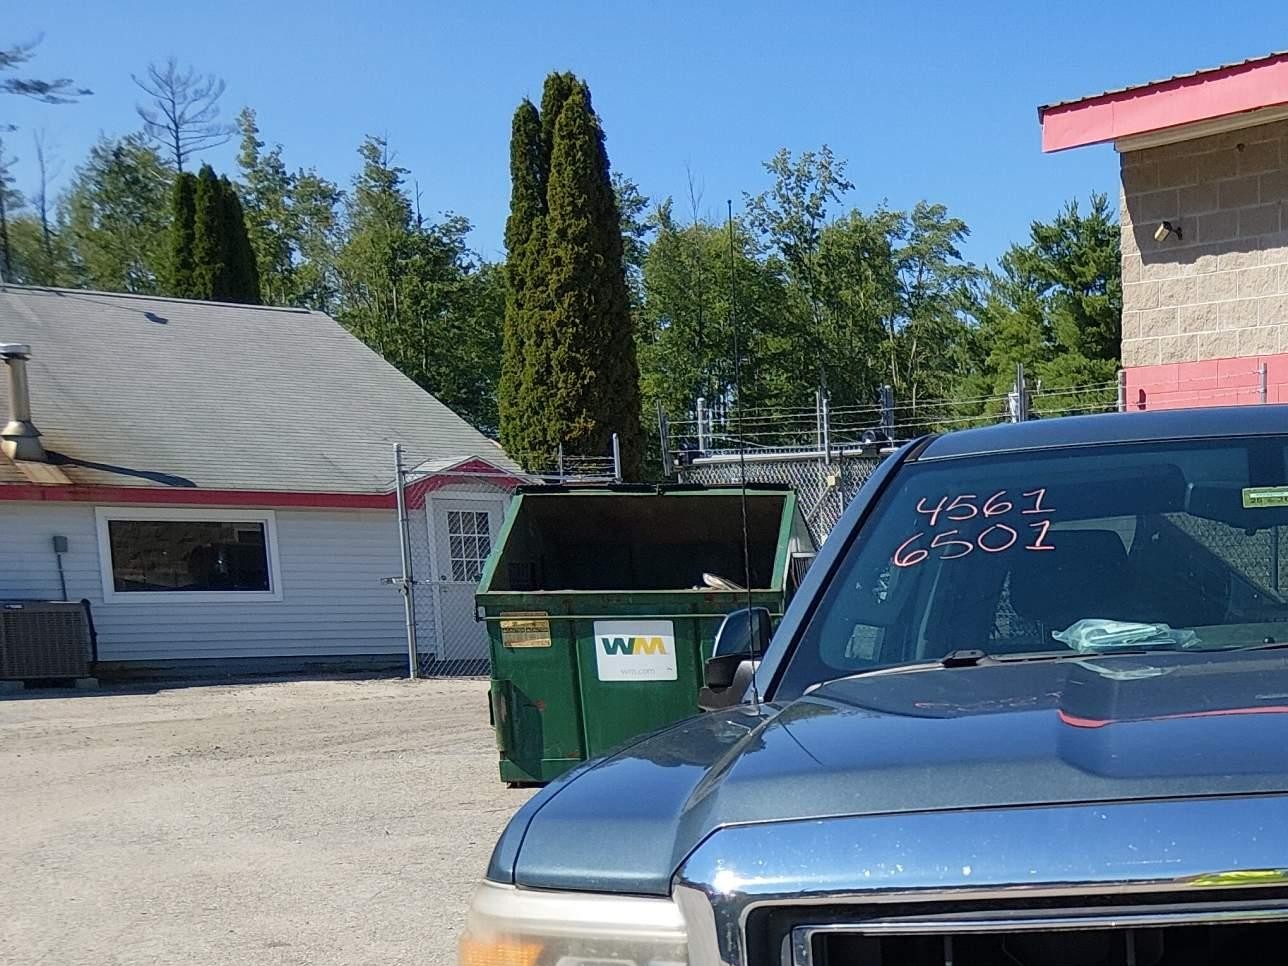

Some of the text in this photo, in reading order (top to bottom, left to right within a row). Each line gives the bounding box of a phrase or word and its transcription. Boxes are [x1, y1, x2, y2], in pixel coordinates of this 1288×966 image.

[916, 488, 1056, 526] 4561
[893, 520, 1056, 567] 6501
[601, 637, 667, 655] WM
